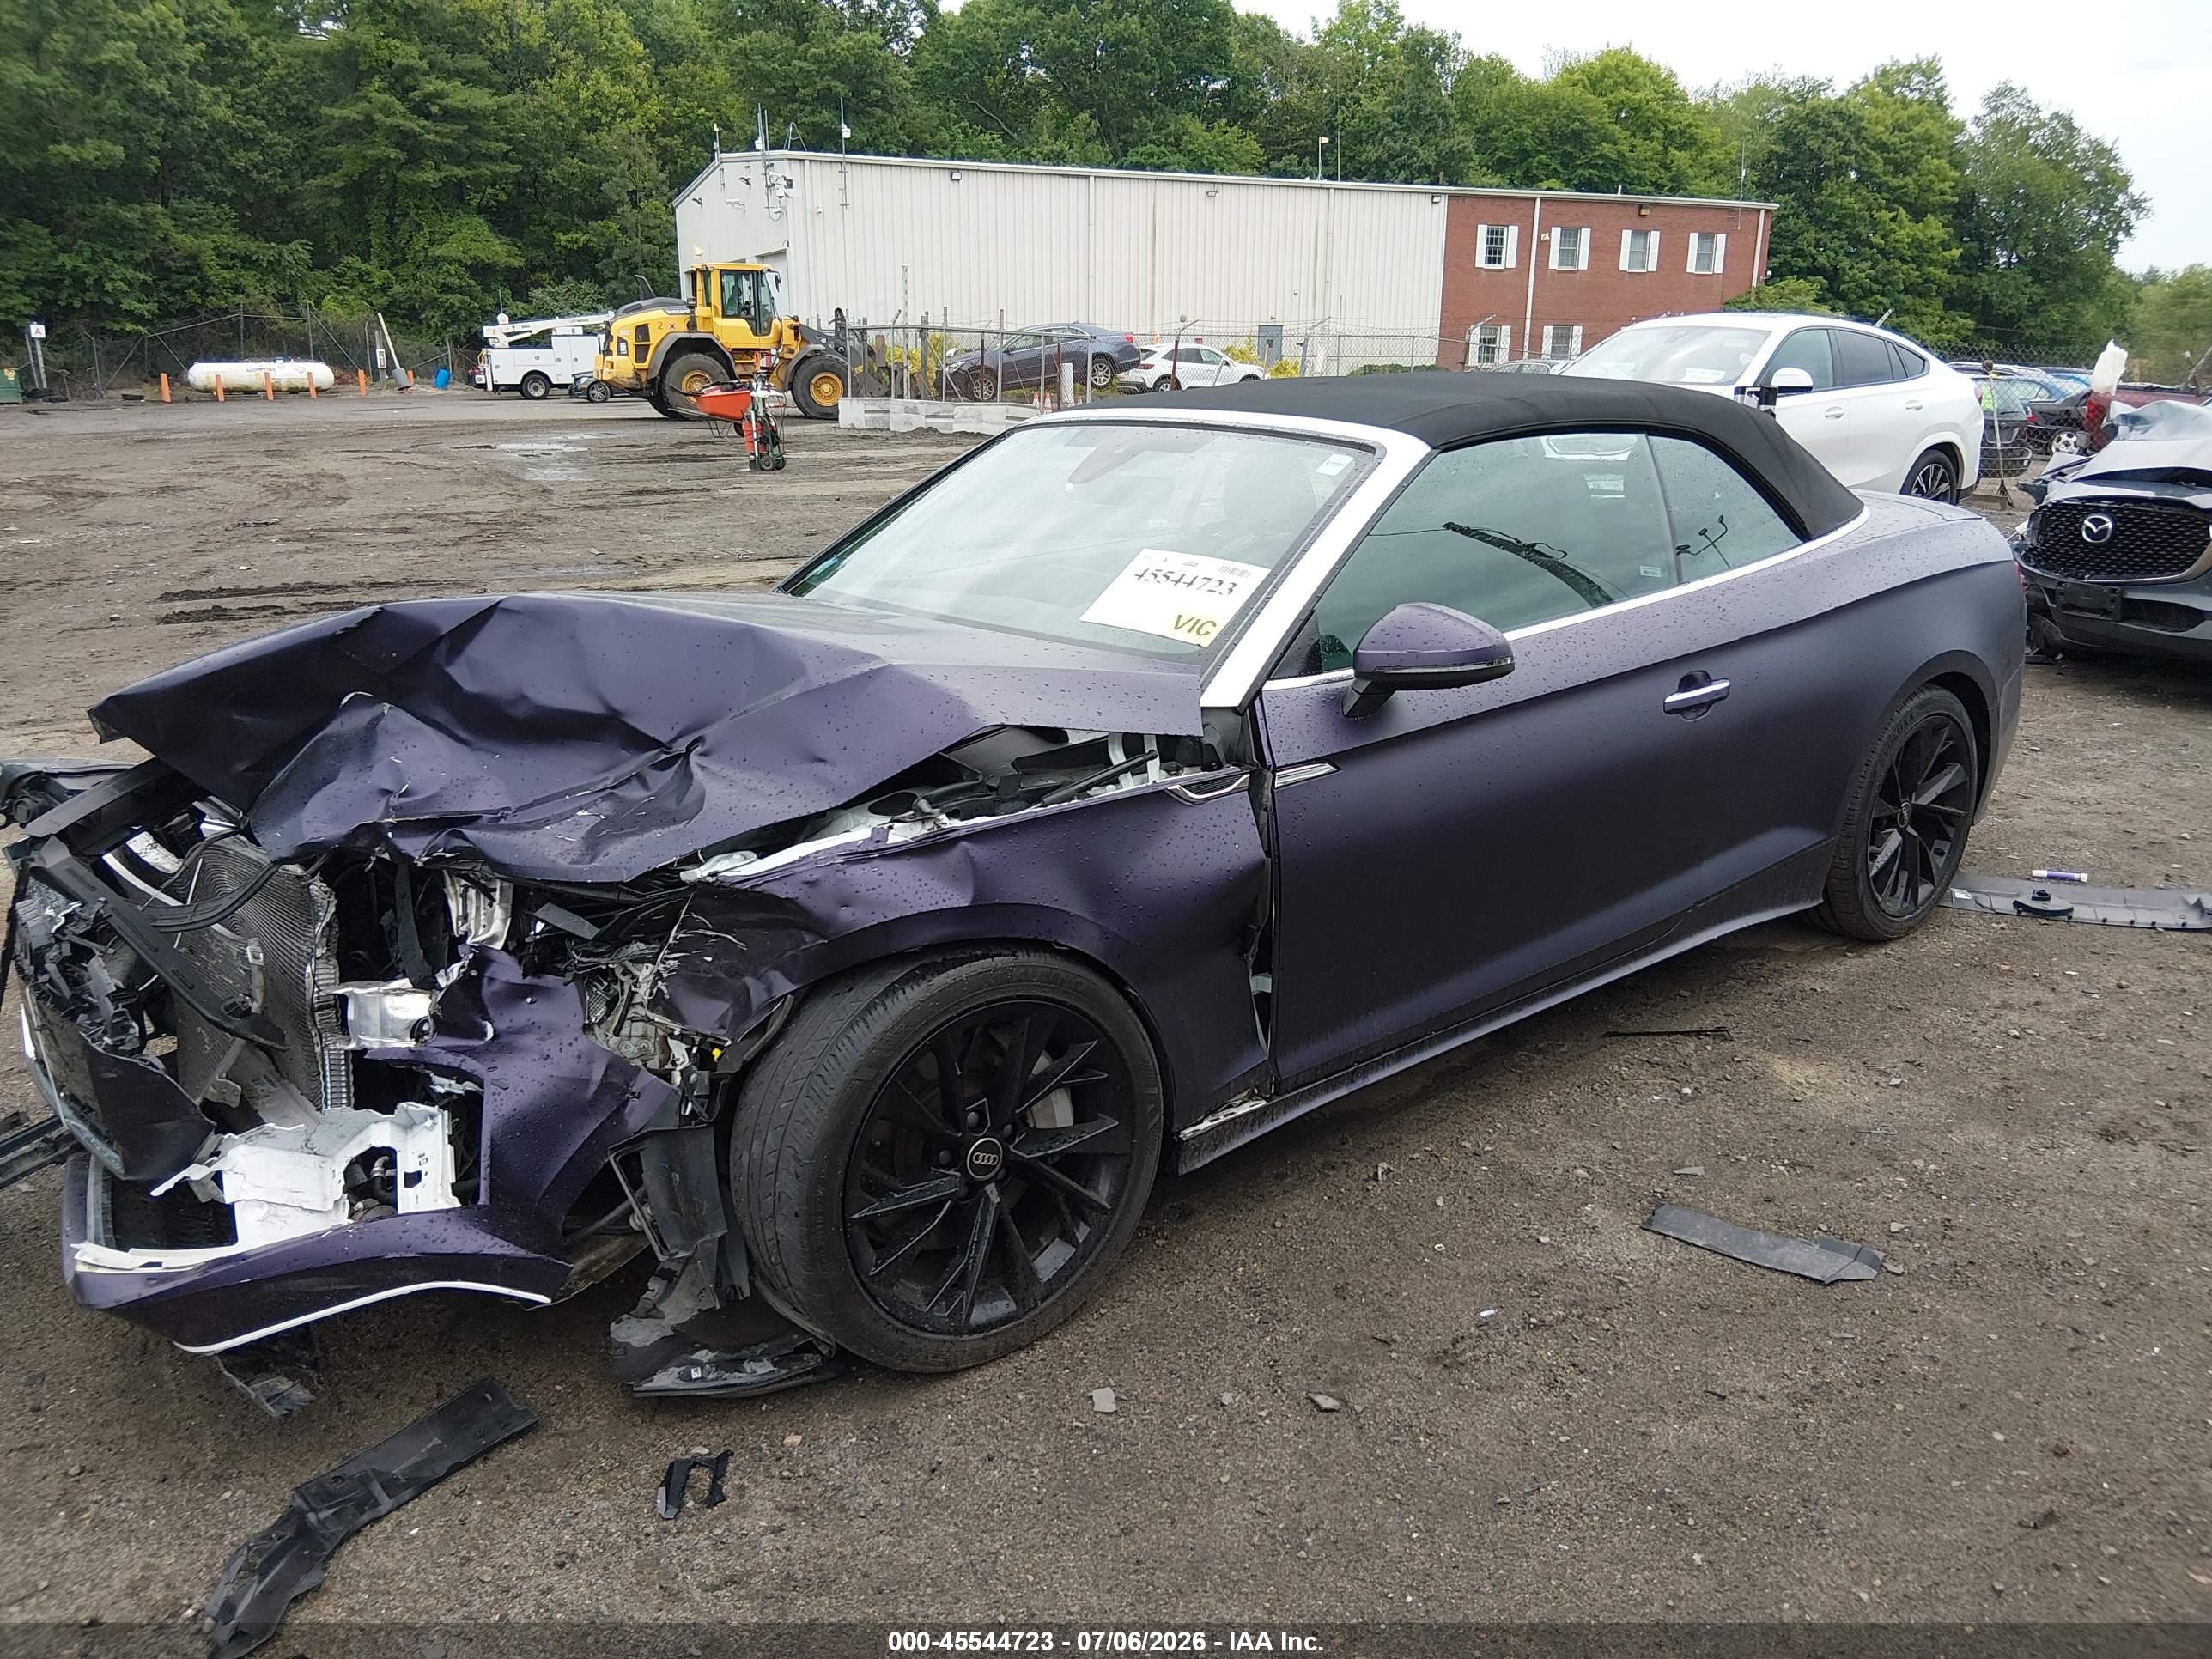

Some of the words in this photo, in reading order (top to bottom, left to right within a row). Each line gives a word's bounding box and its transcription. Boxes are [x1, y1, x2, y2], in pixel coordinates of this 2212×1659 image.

[34, 327, 42, 336] A
[657, 321, 664, 330] 2
[1134, 568, 1237, 595] 45544723
[1173, 614, 1217, 636] VIC
